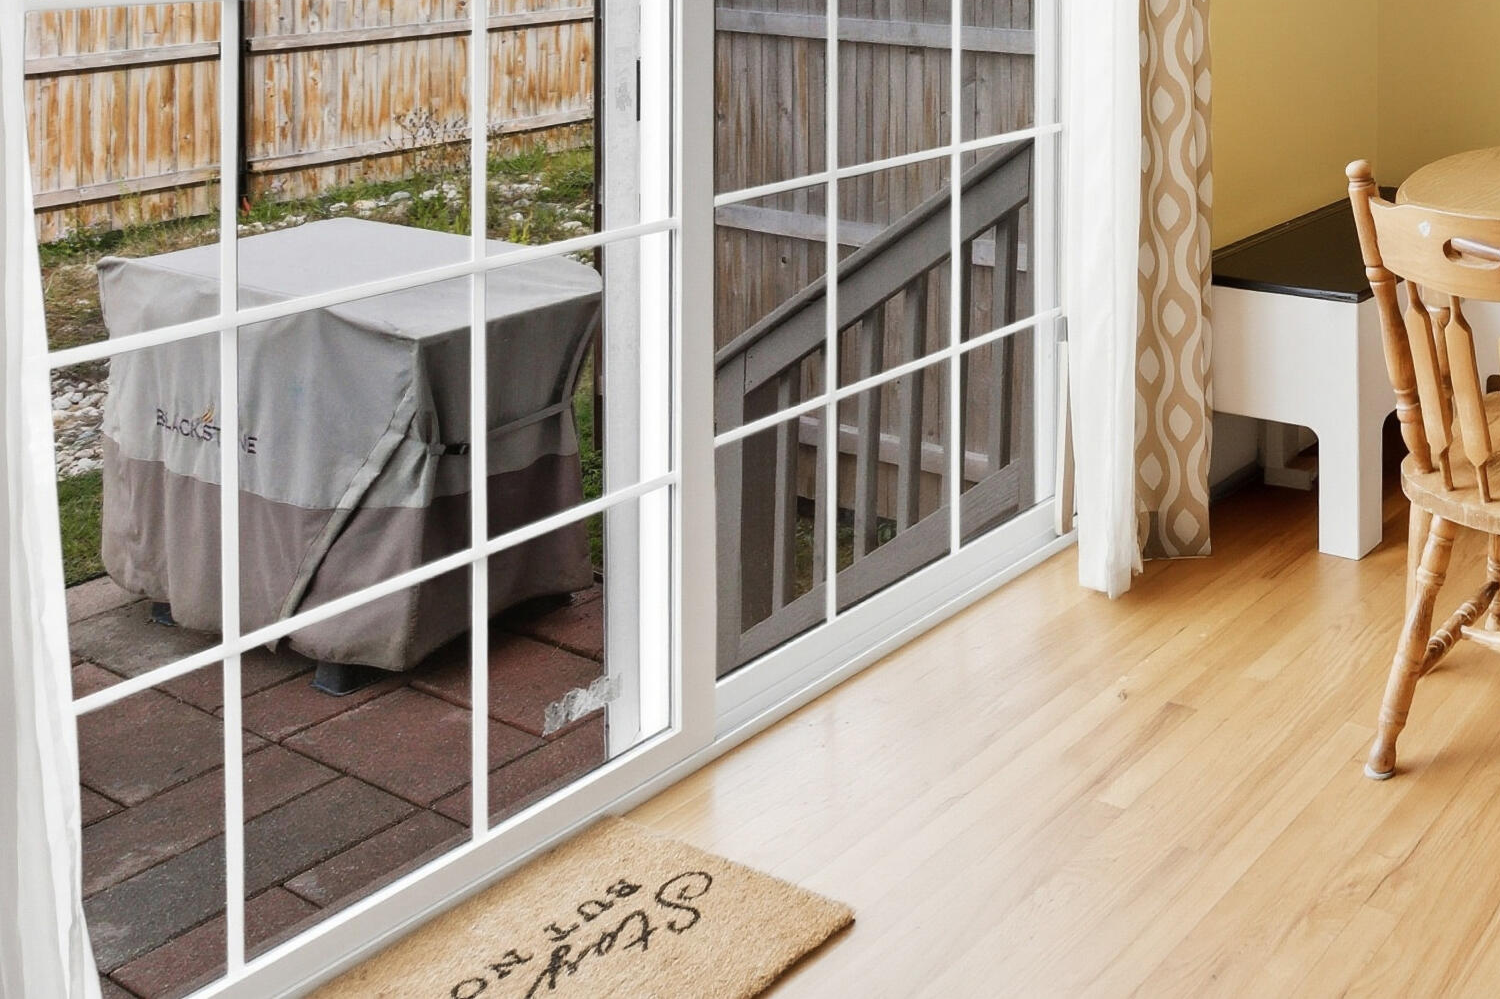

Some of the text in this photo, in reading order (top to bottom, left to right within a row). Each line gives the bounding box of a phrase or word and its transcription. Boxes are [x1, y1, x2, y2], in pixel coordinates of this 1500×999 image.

[156, 408, 258, 455] BLACKSTE
[523, 870, 713, 999] Stay
[543, 878, 643, 942] BUT
